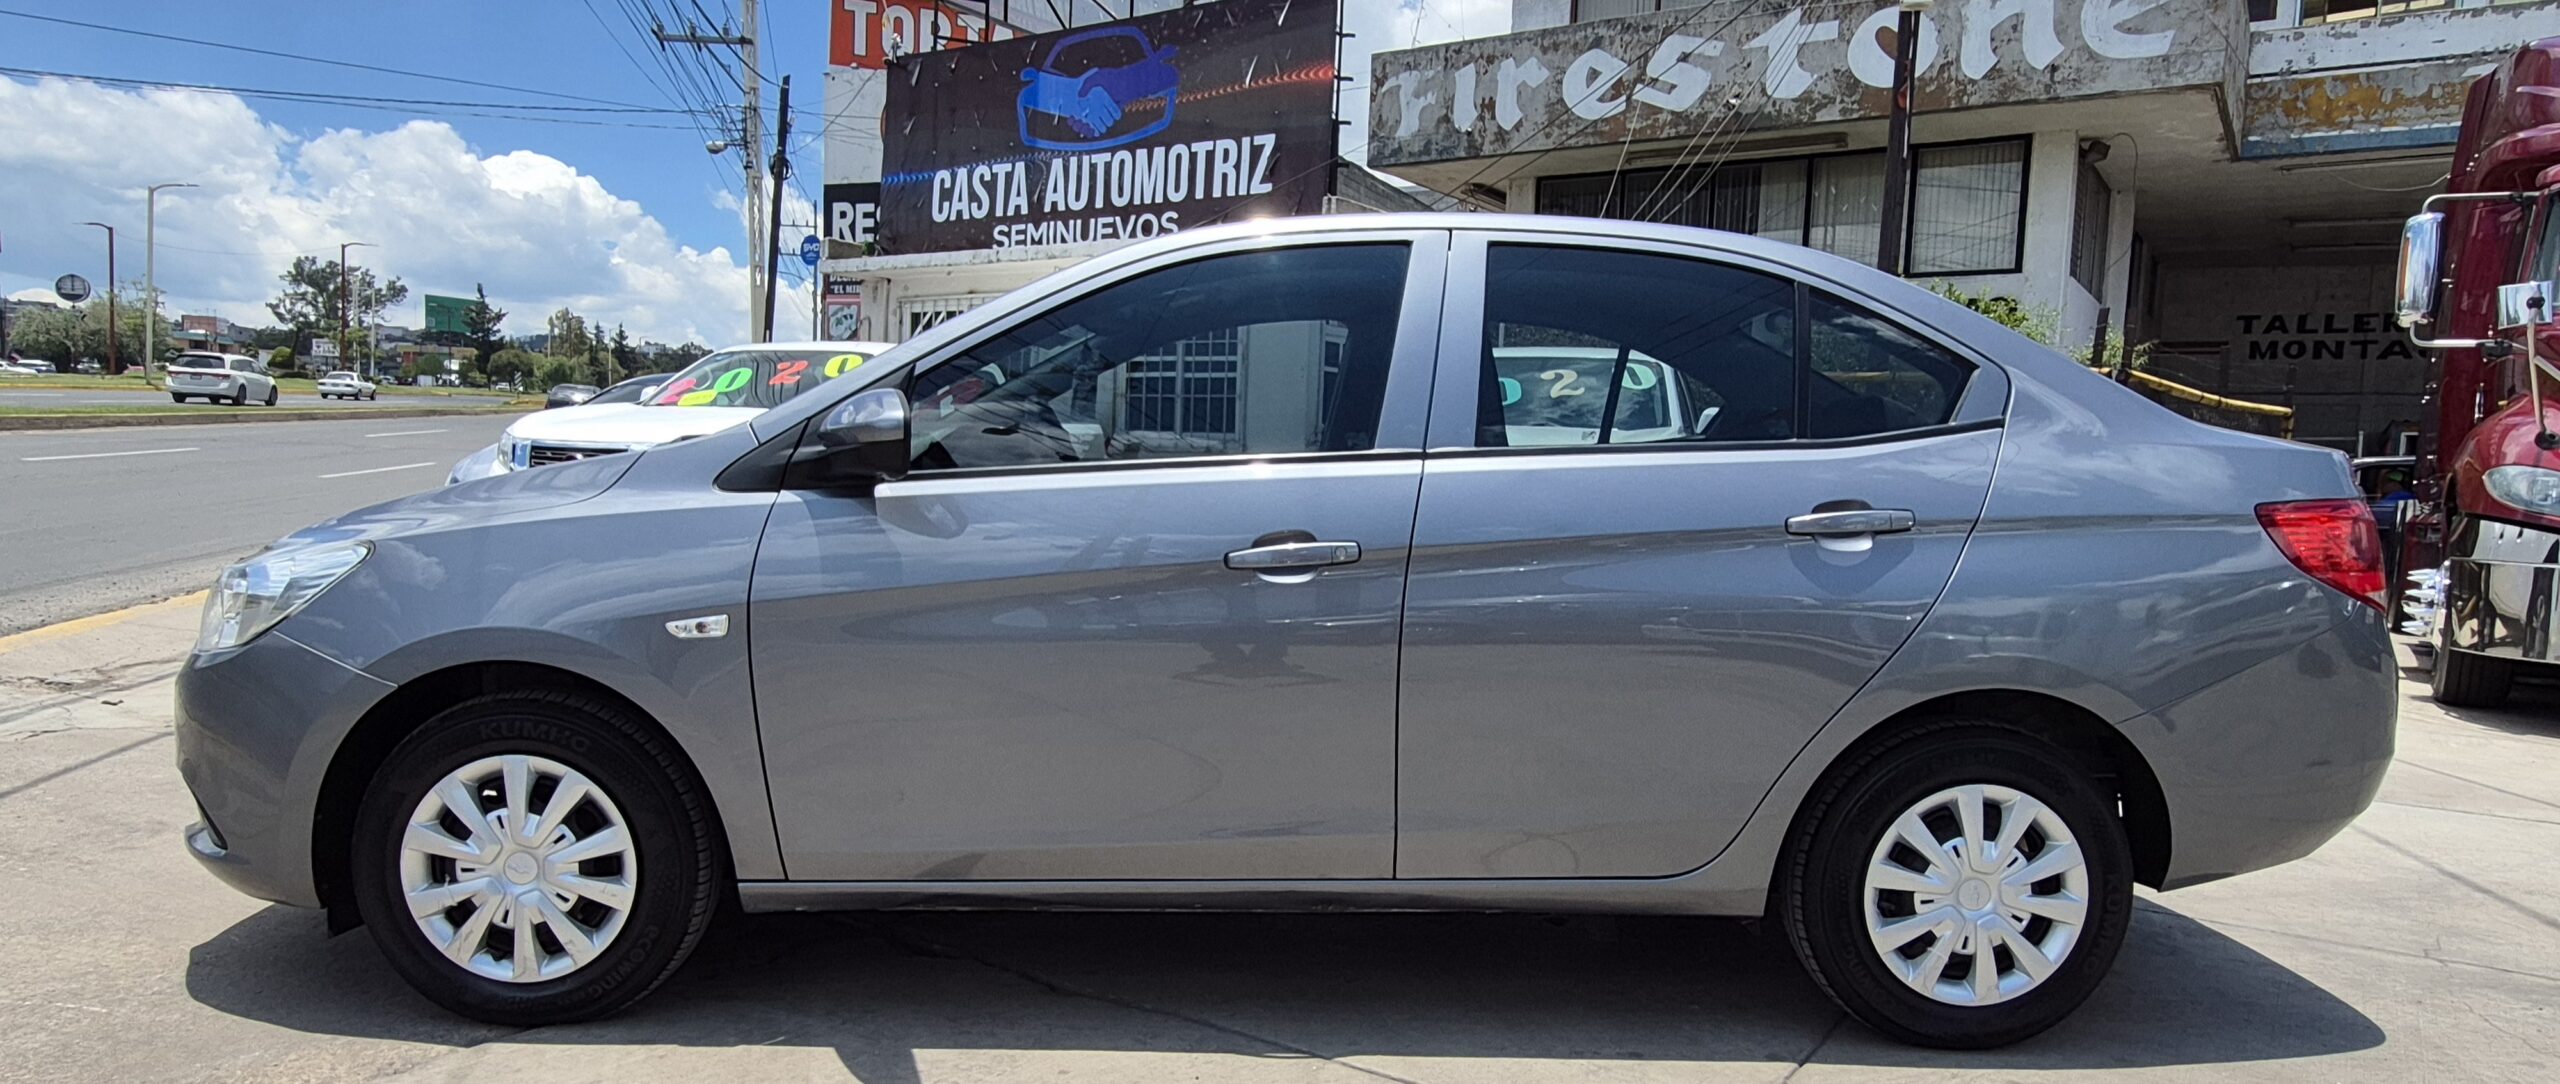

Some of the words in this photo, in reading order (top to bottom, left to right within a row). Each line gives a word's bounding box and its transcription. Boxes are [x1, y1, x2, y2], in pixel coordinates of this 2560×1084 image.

[932, 160, 1029, 222] CASTA
[1044, 134, 1276, 213] AUTOMOTRIZ
[832, 202, 881, 242] RE
[993, 211, 1179, 249] SEMINUEVOS
[2248, 340, 2429, 360] MONTA
[480, 720, 591, 752] KUMHO
